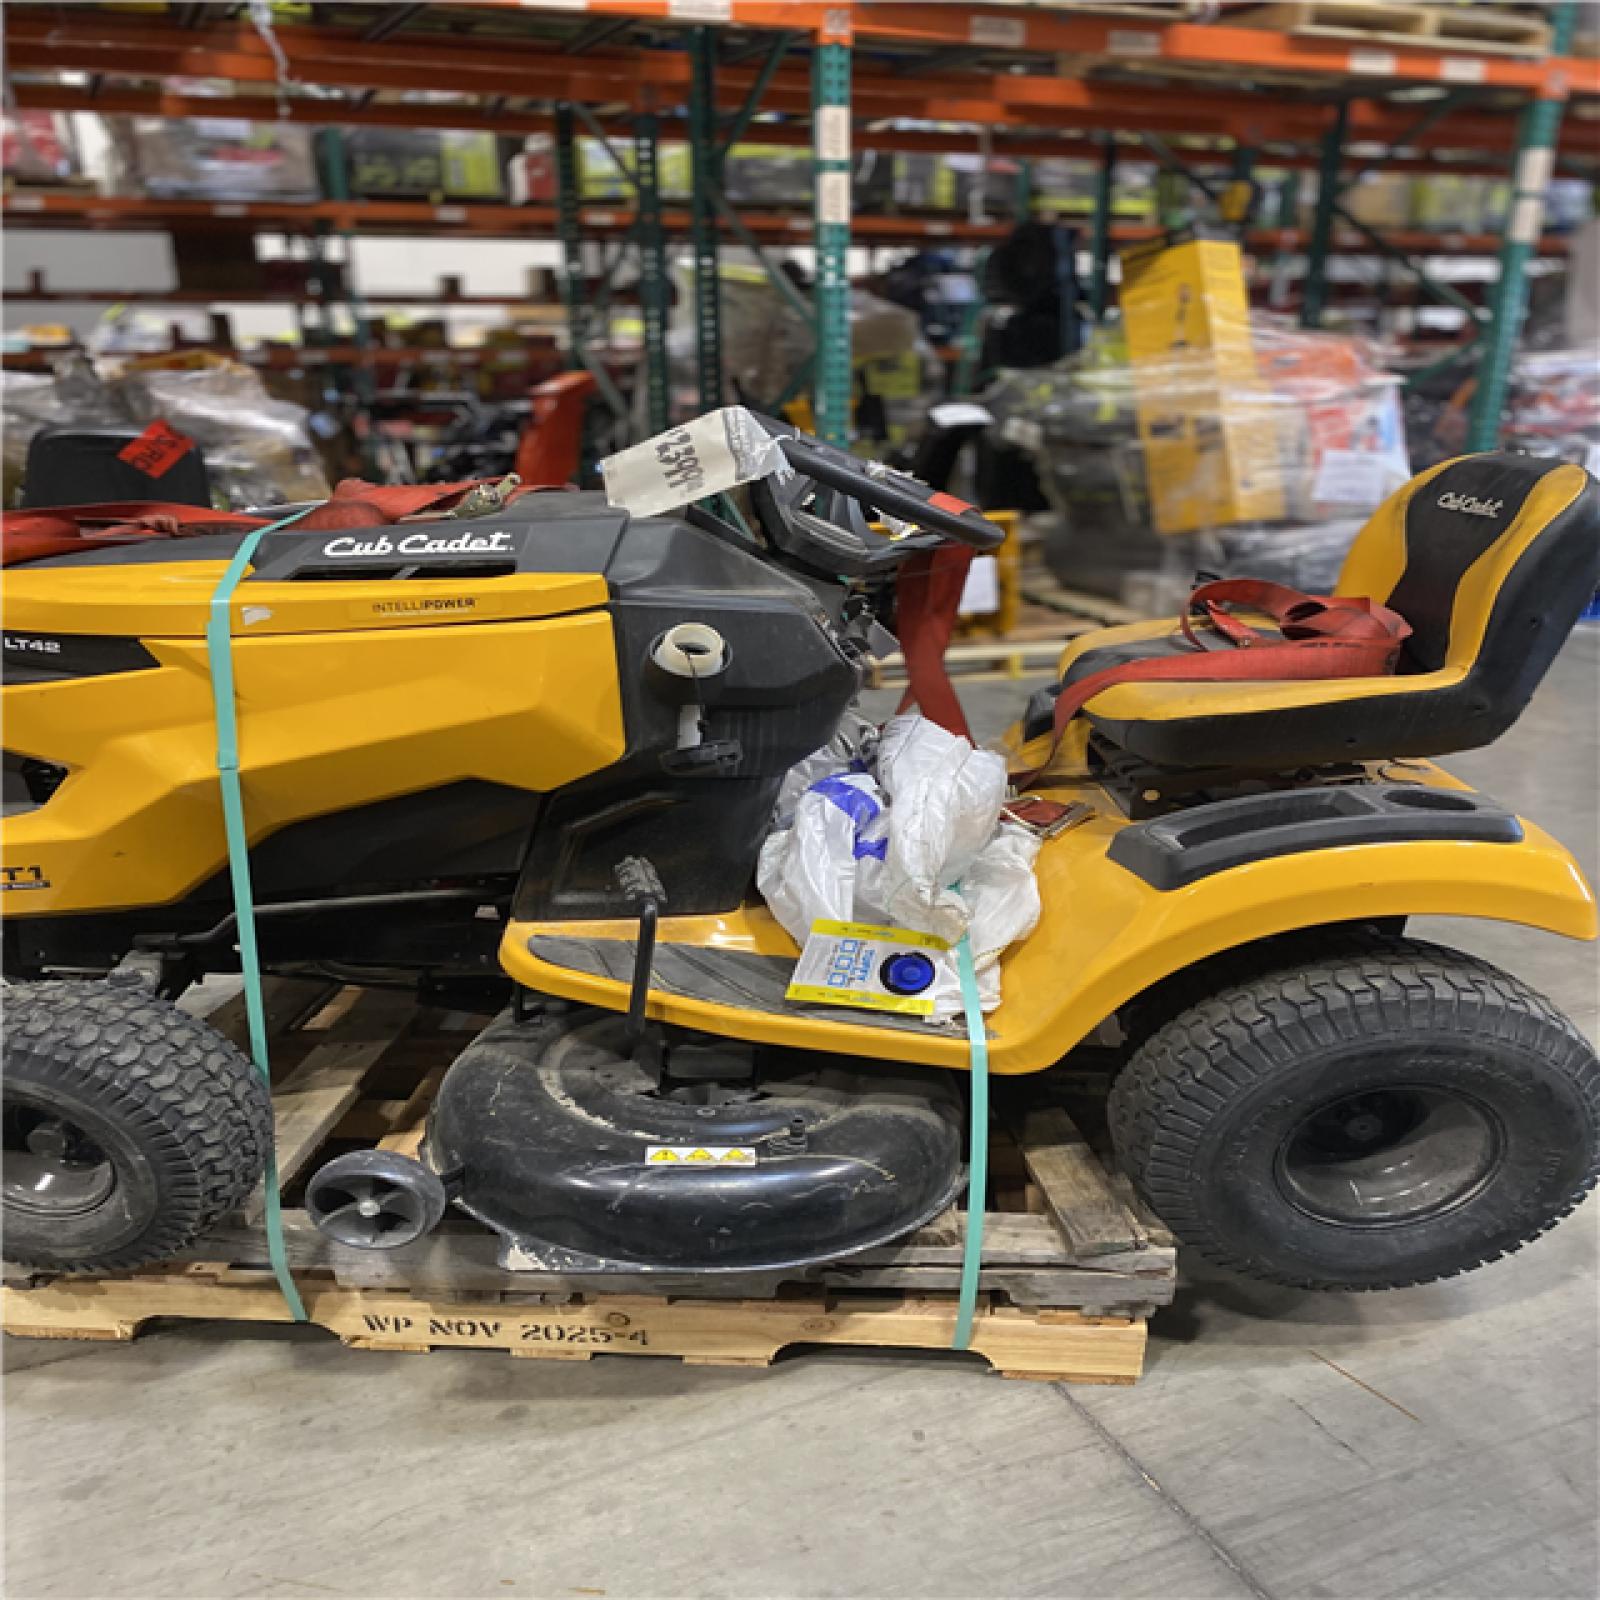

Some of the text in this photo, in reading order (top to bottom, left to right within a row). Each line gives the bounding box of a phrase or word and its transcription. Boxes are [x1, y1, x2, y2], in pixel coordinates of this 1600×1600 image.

[323, 535, 394, 557] Cub
[372, 597, 476, 613] INTELLIPOWER
[4, 637, 61, 654] LT42
[362, 1314, 649, 1346] WP NOV 2025-4
